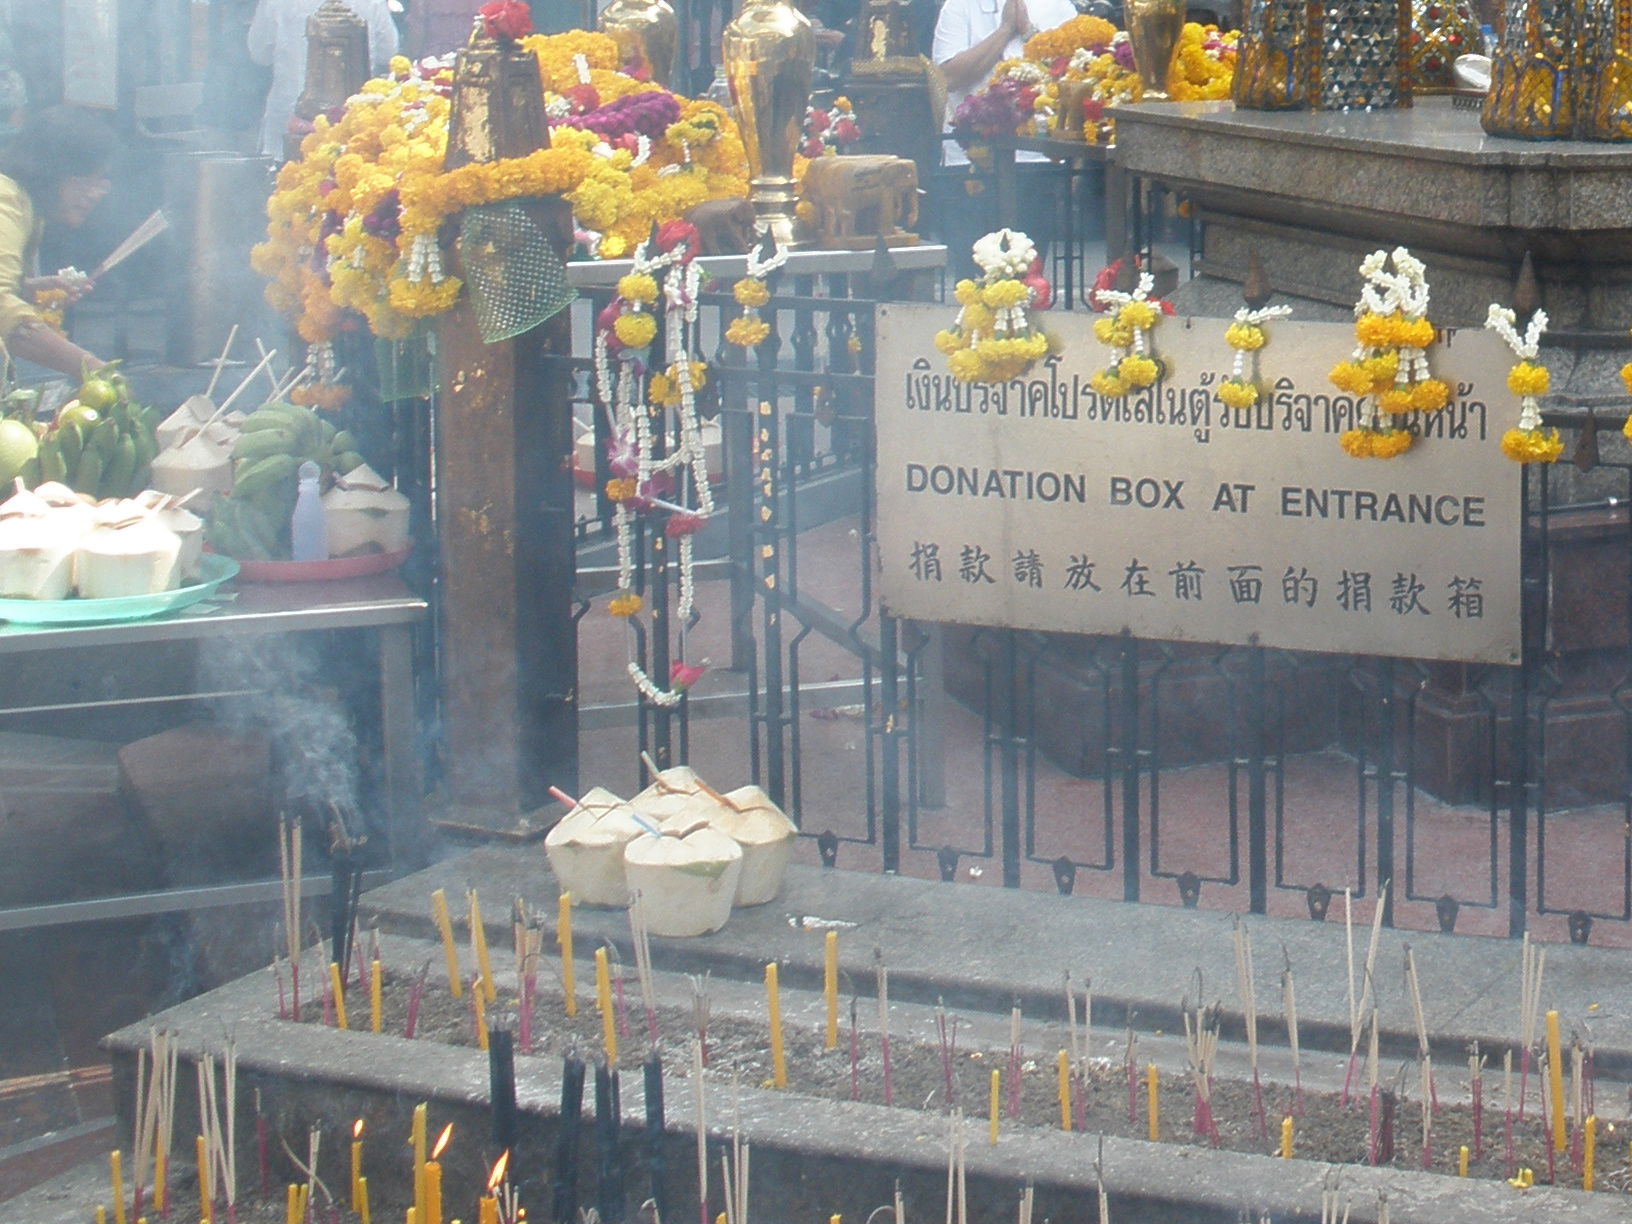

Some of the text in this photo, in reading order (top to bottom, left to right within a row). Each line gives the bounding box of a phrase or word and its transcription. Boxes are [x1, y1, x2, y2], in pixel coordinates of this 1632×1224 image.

[905, 463, 1486, 528] DONATION BOX AT ENTRANCE
[907, 540, 1485, 620] 捐款請放在前面的捐款箱
